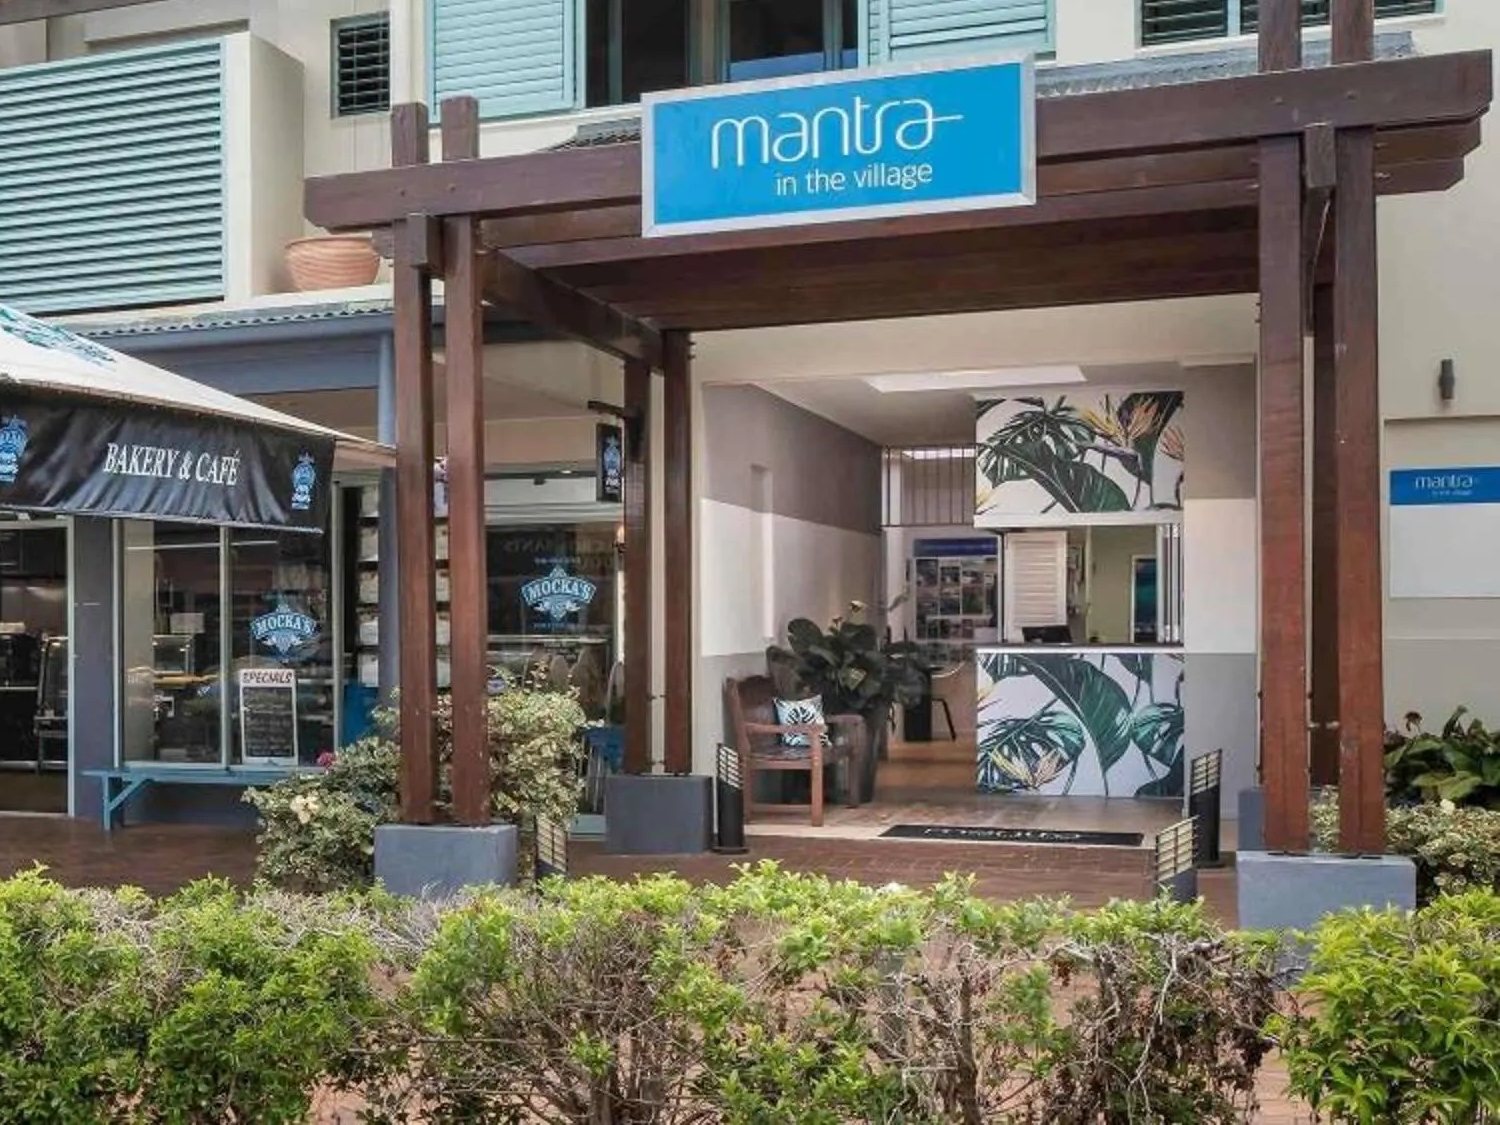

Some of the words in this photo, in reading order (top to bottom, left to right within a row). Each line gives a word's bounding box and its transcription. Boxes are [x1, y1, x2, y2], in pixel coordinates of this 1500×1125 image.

[711, 95, 964, 169] mantra
[776, 173, 797, 196] in
[806, 169, 846, 193] the
[853, 162, 933, 190] village
[103, 442, 180, 478] BAKERY
[179, 451, 192, 481] &
[195, 450, 240, 486] CAFÉ
[1415, 475, 1474, 489] mantra
